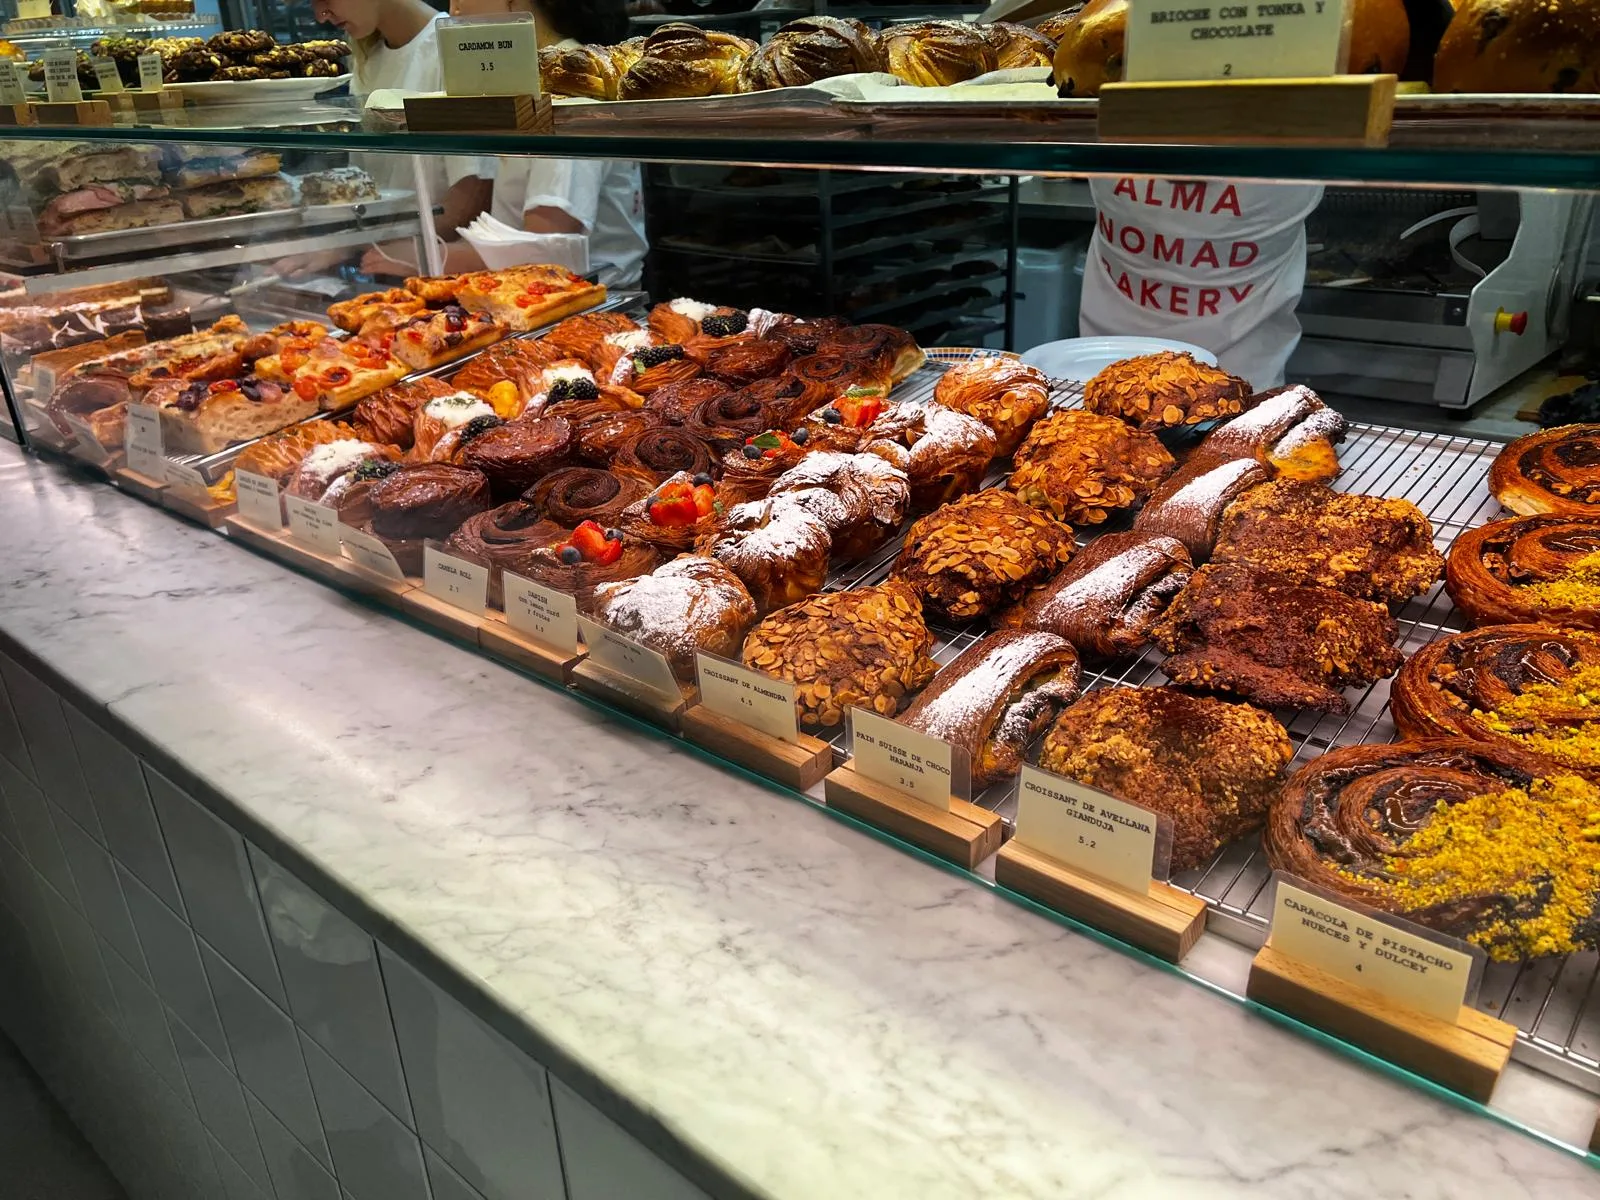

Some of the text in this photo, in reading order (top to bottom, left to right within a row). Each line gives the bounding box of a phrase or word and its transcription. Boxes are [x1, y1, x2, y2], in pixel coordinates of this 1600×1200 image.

[1151, 1, 1325, 24] BRIOCHE CON TONKA Y
[1191, 24, 1274, 40] CHOCOLATE
[458, 40, 513, 51] CARDAMOM BUN
[480, 62, 494, 71] 3.5
[1222, 64, 1232, 76] 2
[1113, 177, 1242, 217] ALMA
[1099, 210, 1260, 268] NOMAD
[703, 668, 787, 702] CROISSANT DE ALMENDRA
[856, 731, 951, 776] PAIN SUISSE DE CHOCO
[889, 755, 925, 774] NARANJA
[899, 777, 914, 788] 3.5
[1024, 781, 1151, 834] CROISSANT DE AVELLANA
[1066, 808, 1115, 833] GIANDUJA
[1078, 835, 1097, 849] 5.2
[1283, 898, 1454, 971] CARACOLA DE PISTACHO
[1301, 917, 1429, 974] NUECES Y DULCEY
[1354, 963, 1363, 973] 4
